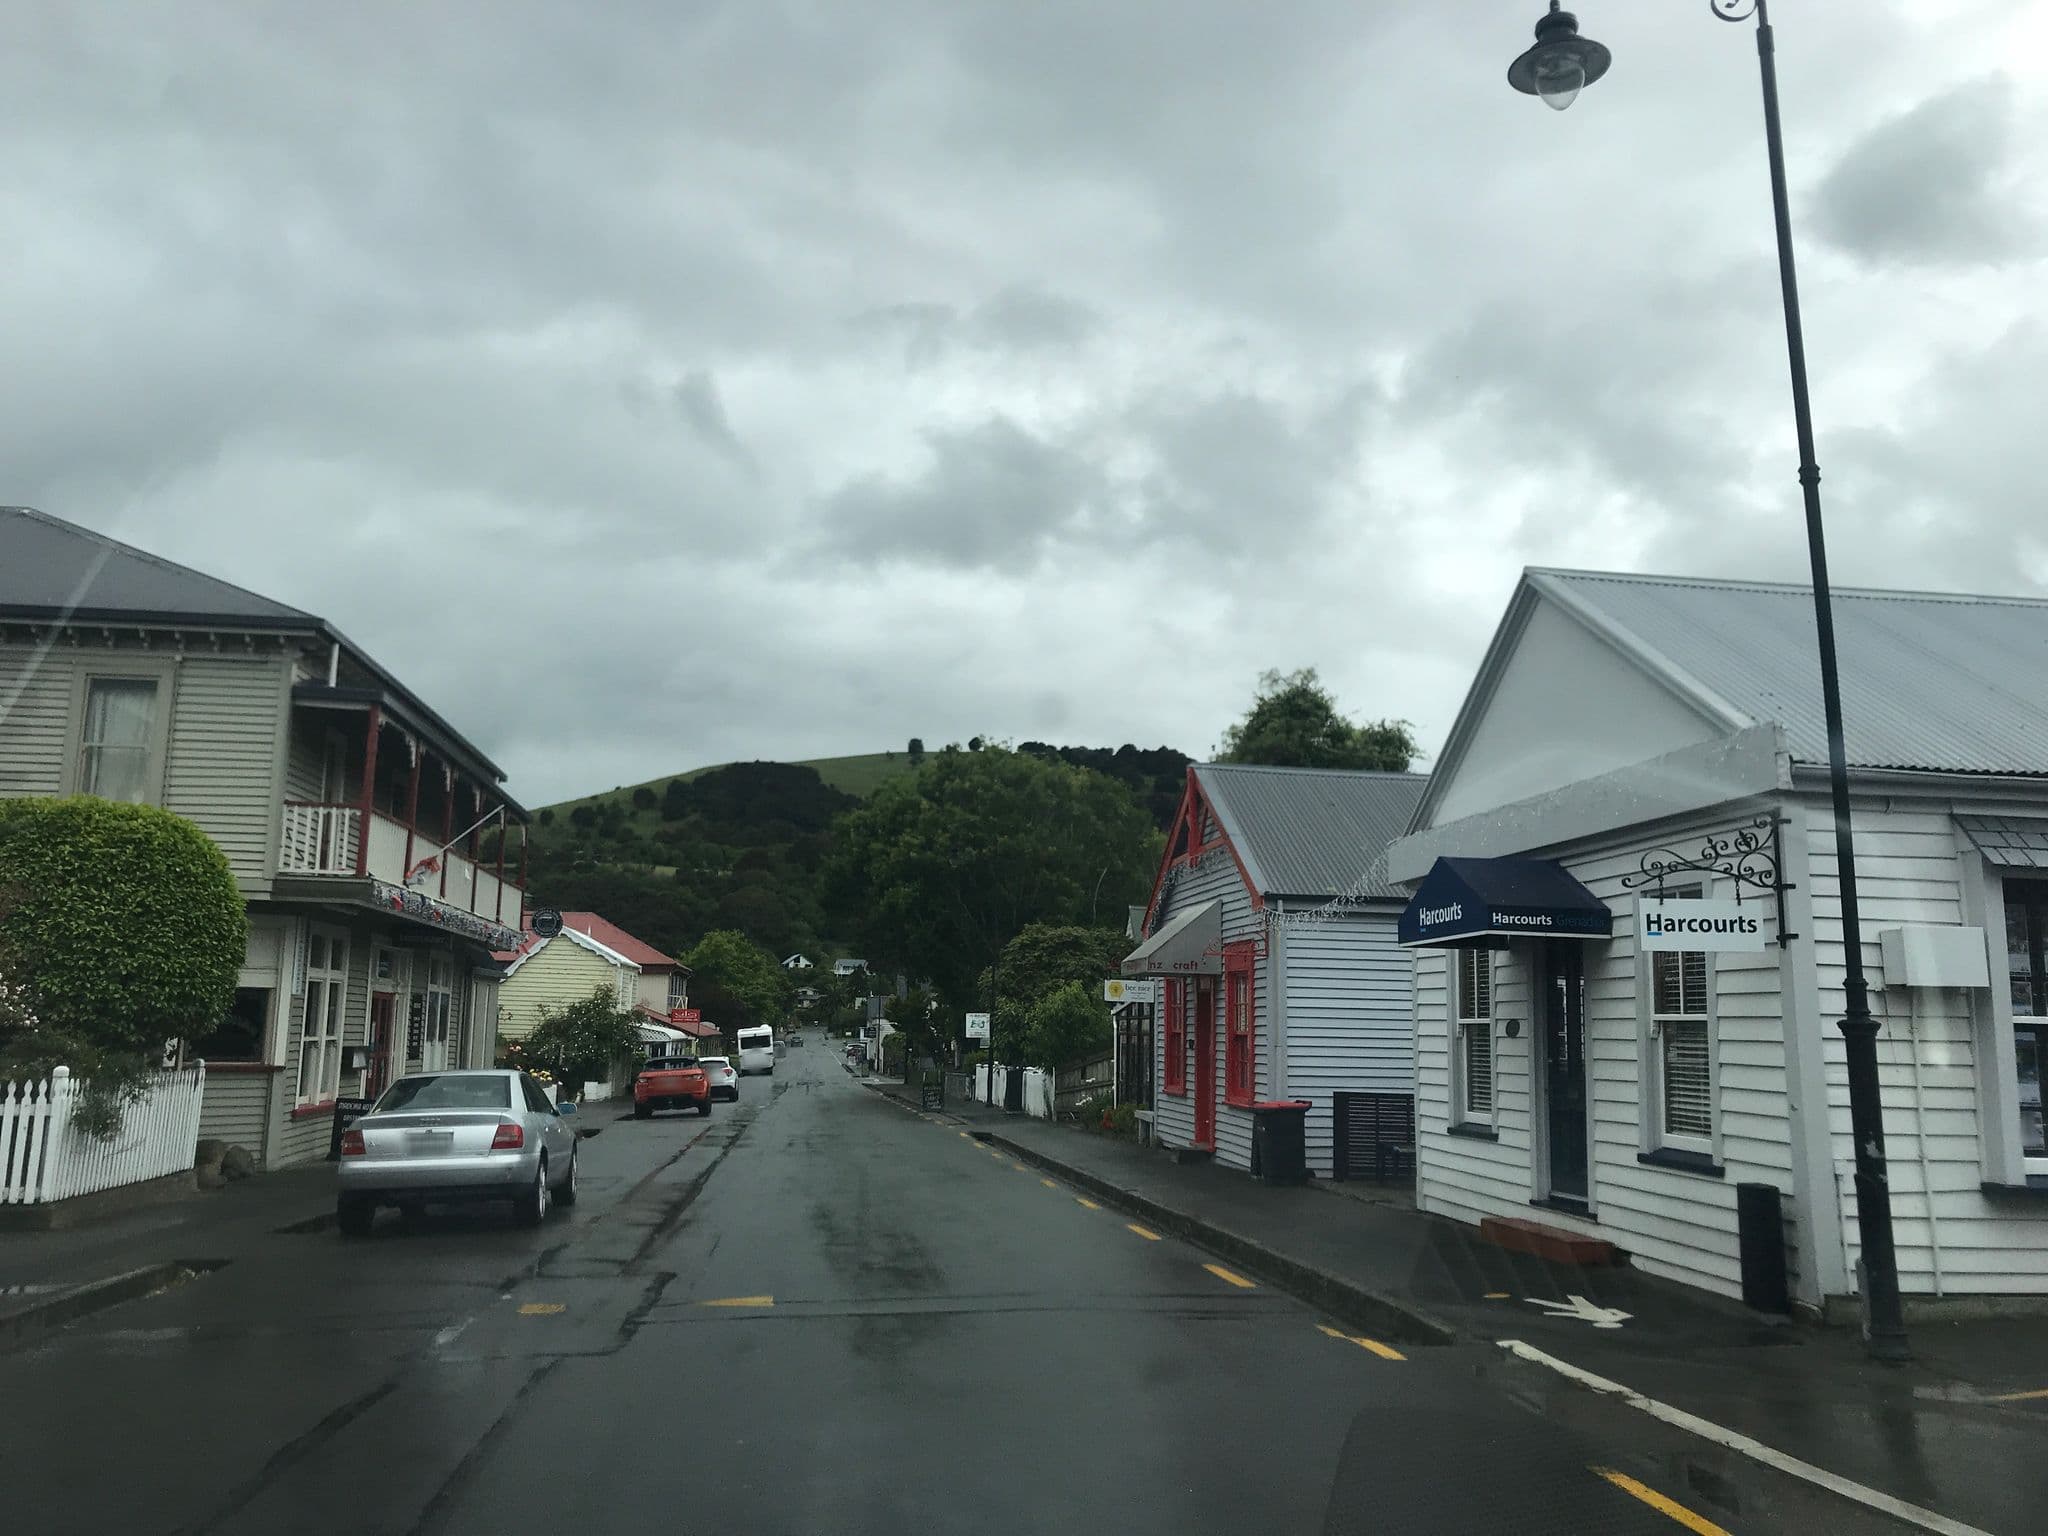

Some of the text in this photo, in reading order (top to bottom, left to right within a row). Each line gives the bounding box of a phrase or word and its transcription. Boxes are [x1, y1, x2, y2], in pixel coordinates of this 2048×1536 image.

[1419, 902, 1462, 926] Harcourts
[1492, 912, 1553, 926] Harcourts
[1645, 913, 1758, 934] Harcourts
[1149, 961, 1163, 970] nz
[1173, 960, 1198, 970] craft
